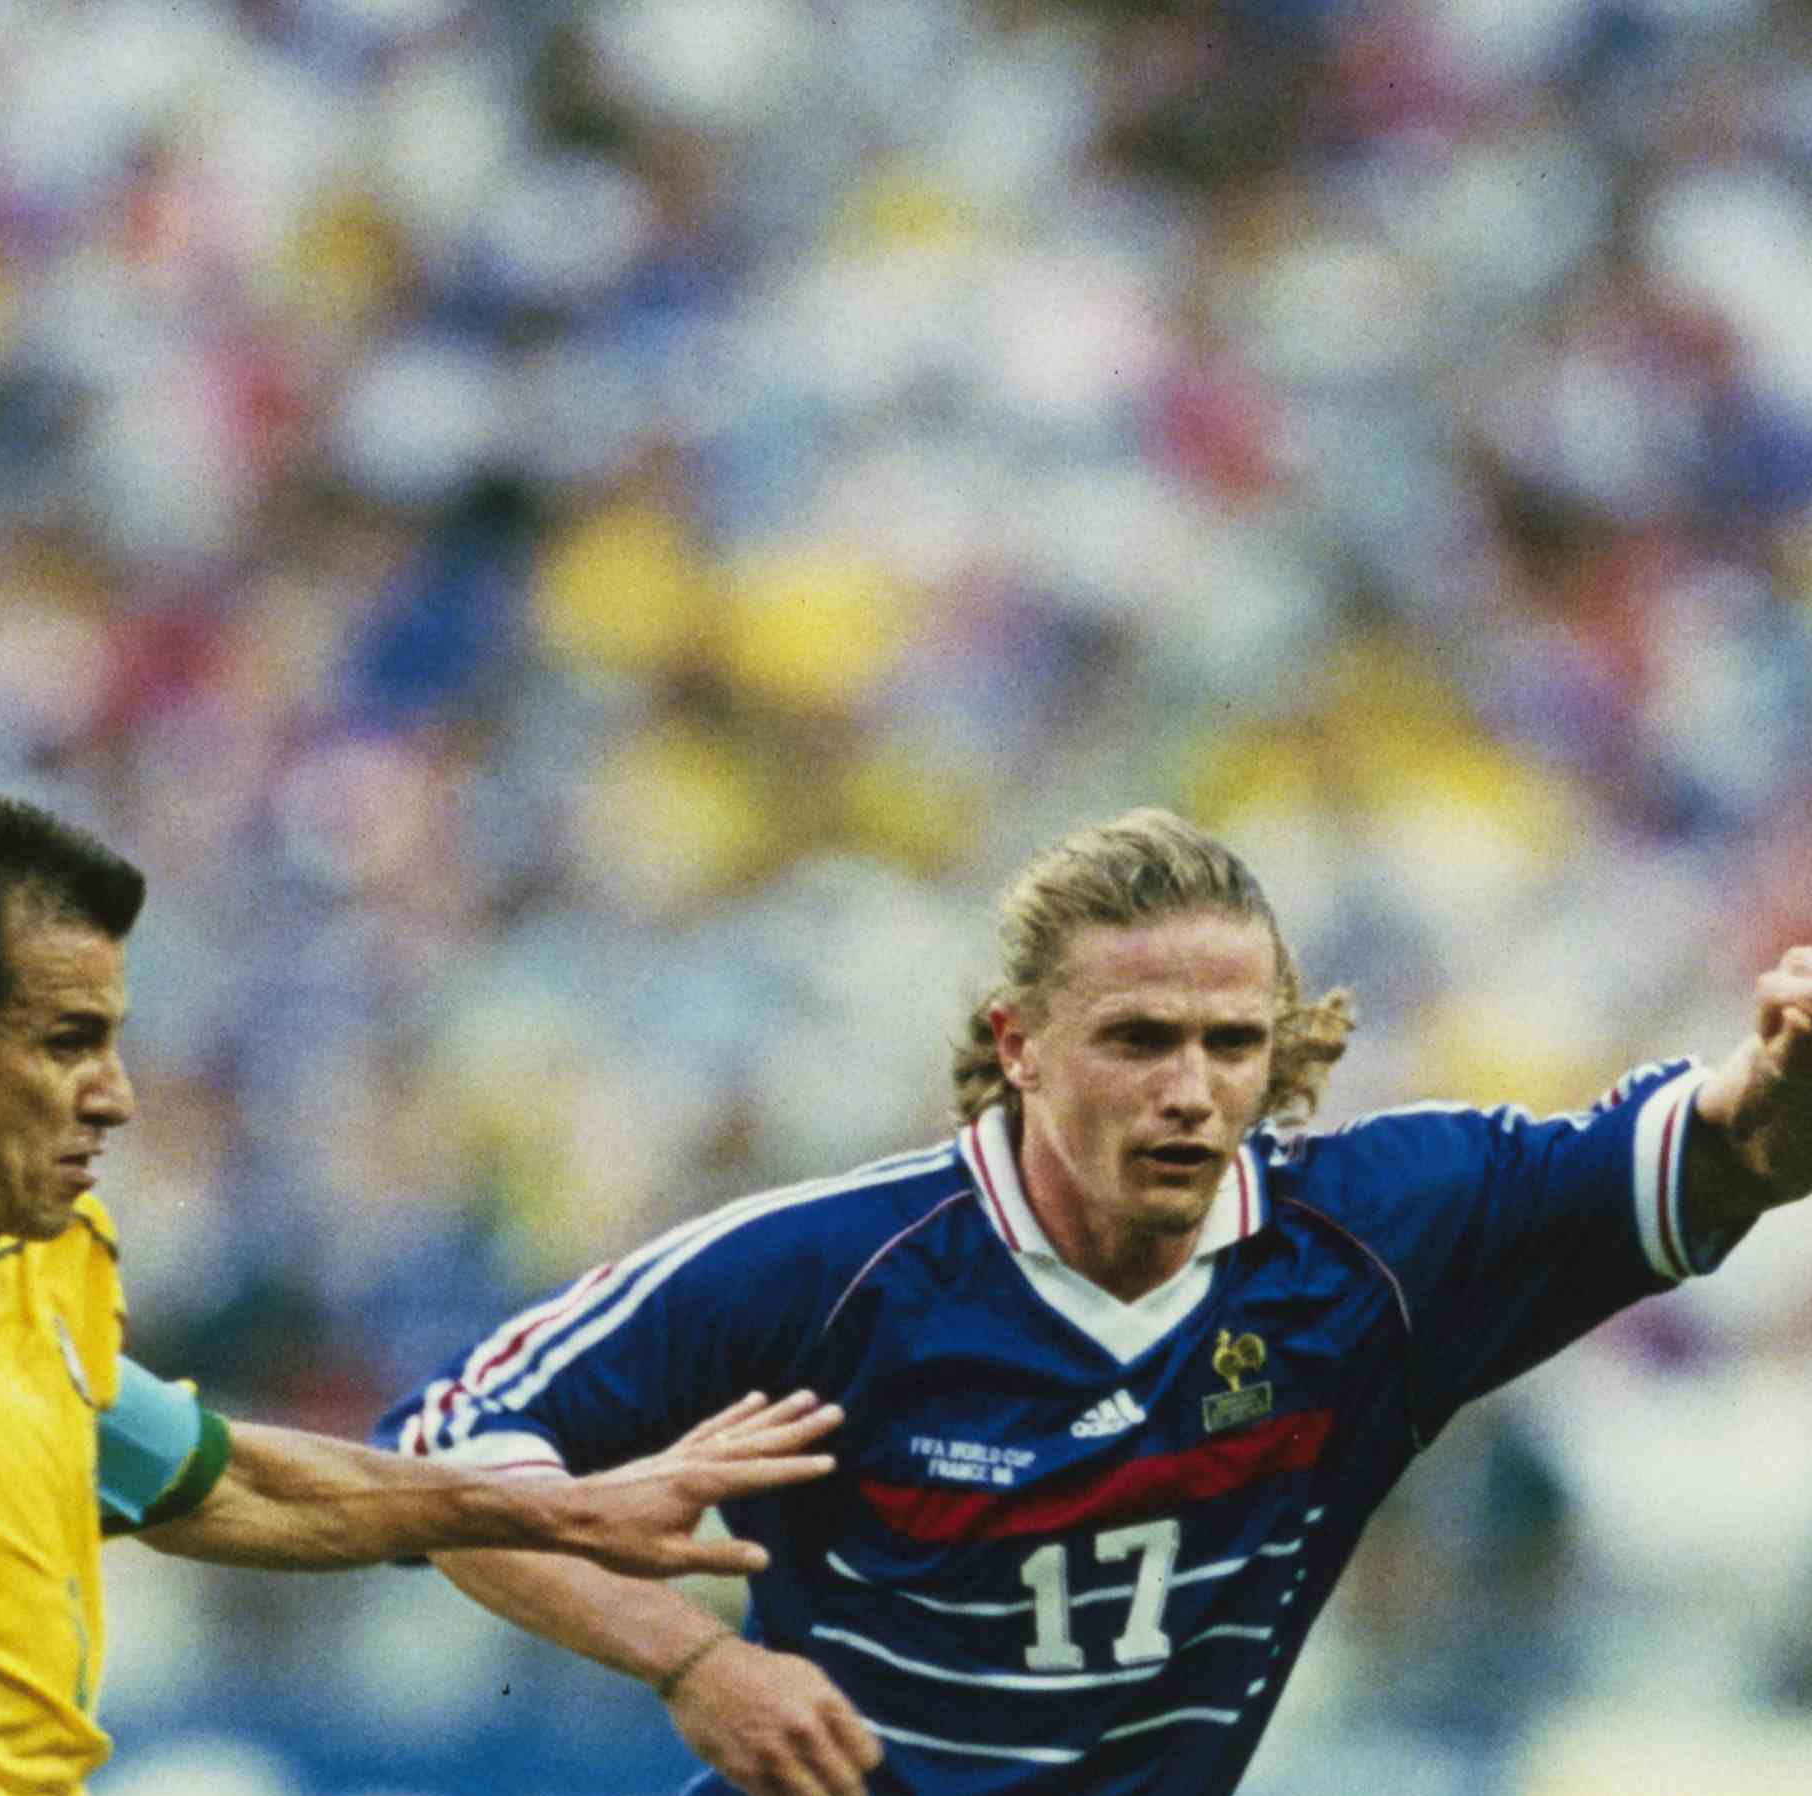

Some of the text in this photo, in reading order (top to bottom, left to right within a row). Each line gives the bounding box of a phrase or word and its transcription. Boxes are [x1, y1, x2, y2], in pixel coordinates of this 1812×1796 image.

[910, 1436, 1036, 1468] FIFA WORLD CUP
[927, 1458, 987, 1481] FRANCE
[1020, 1519, 1181, 1670] 17
